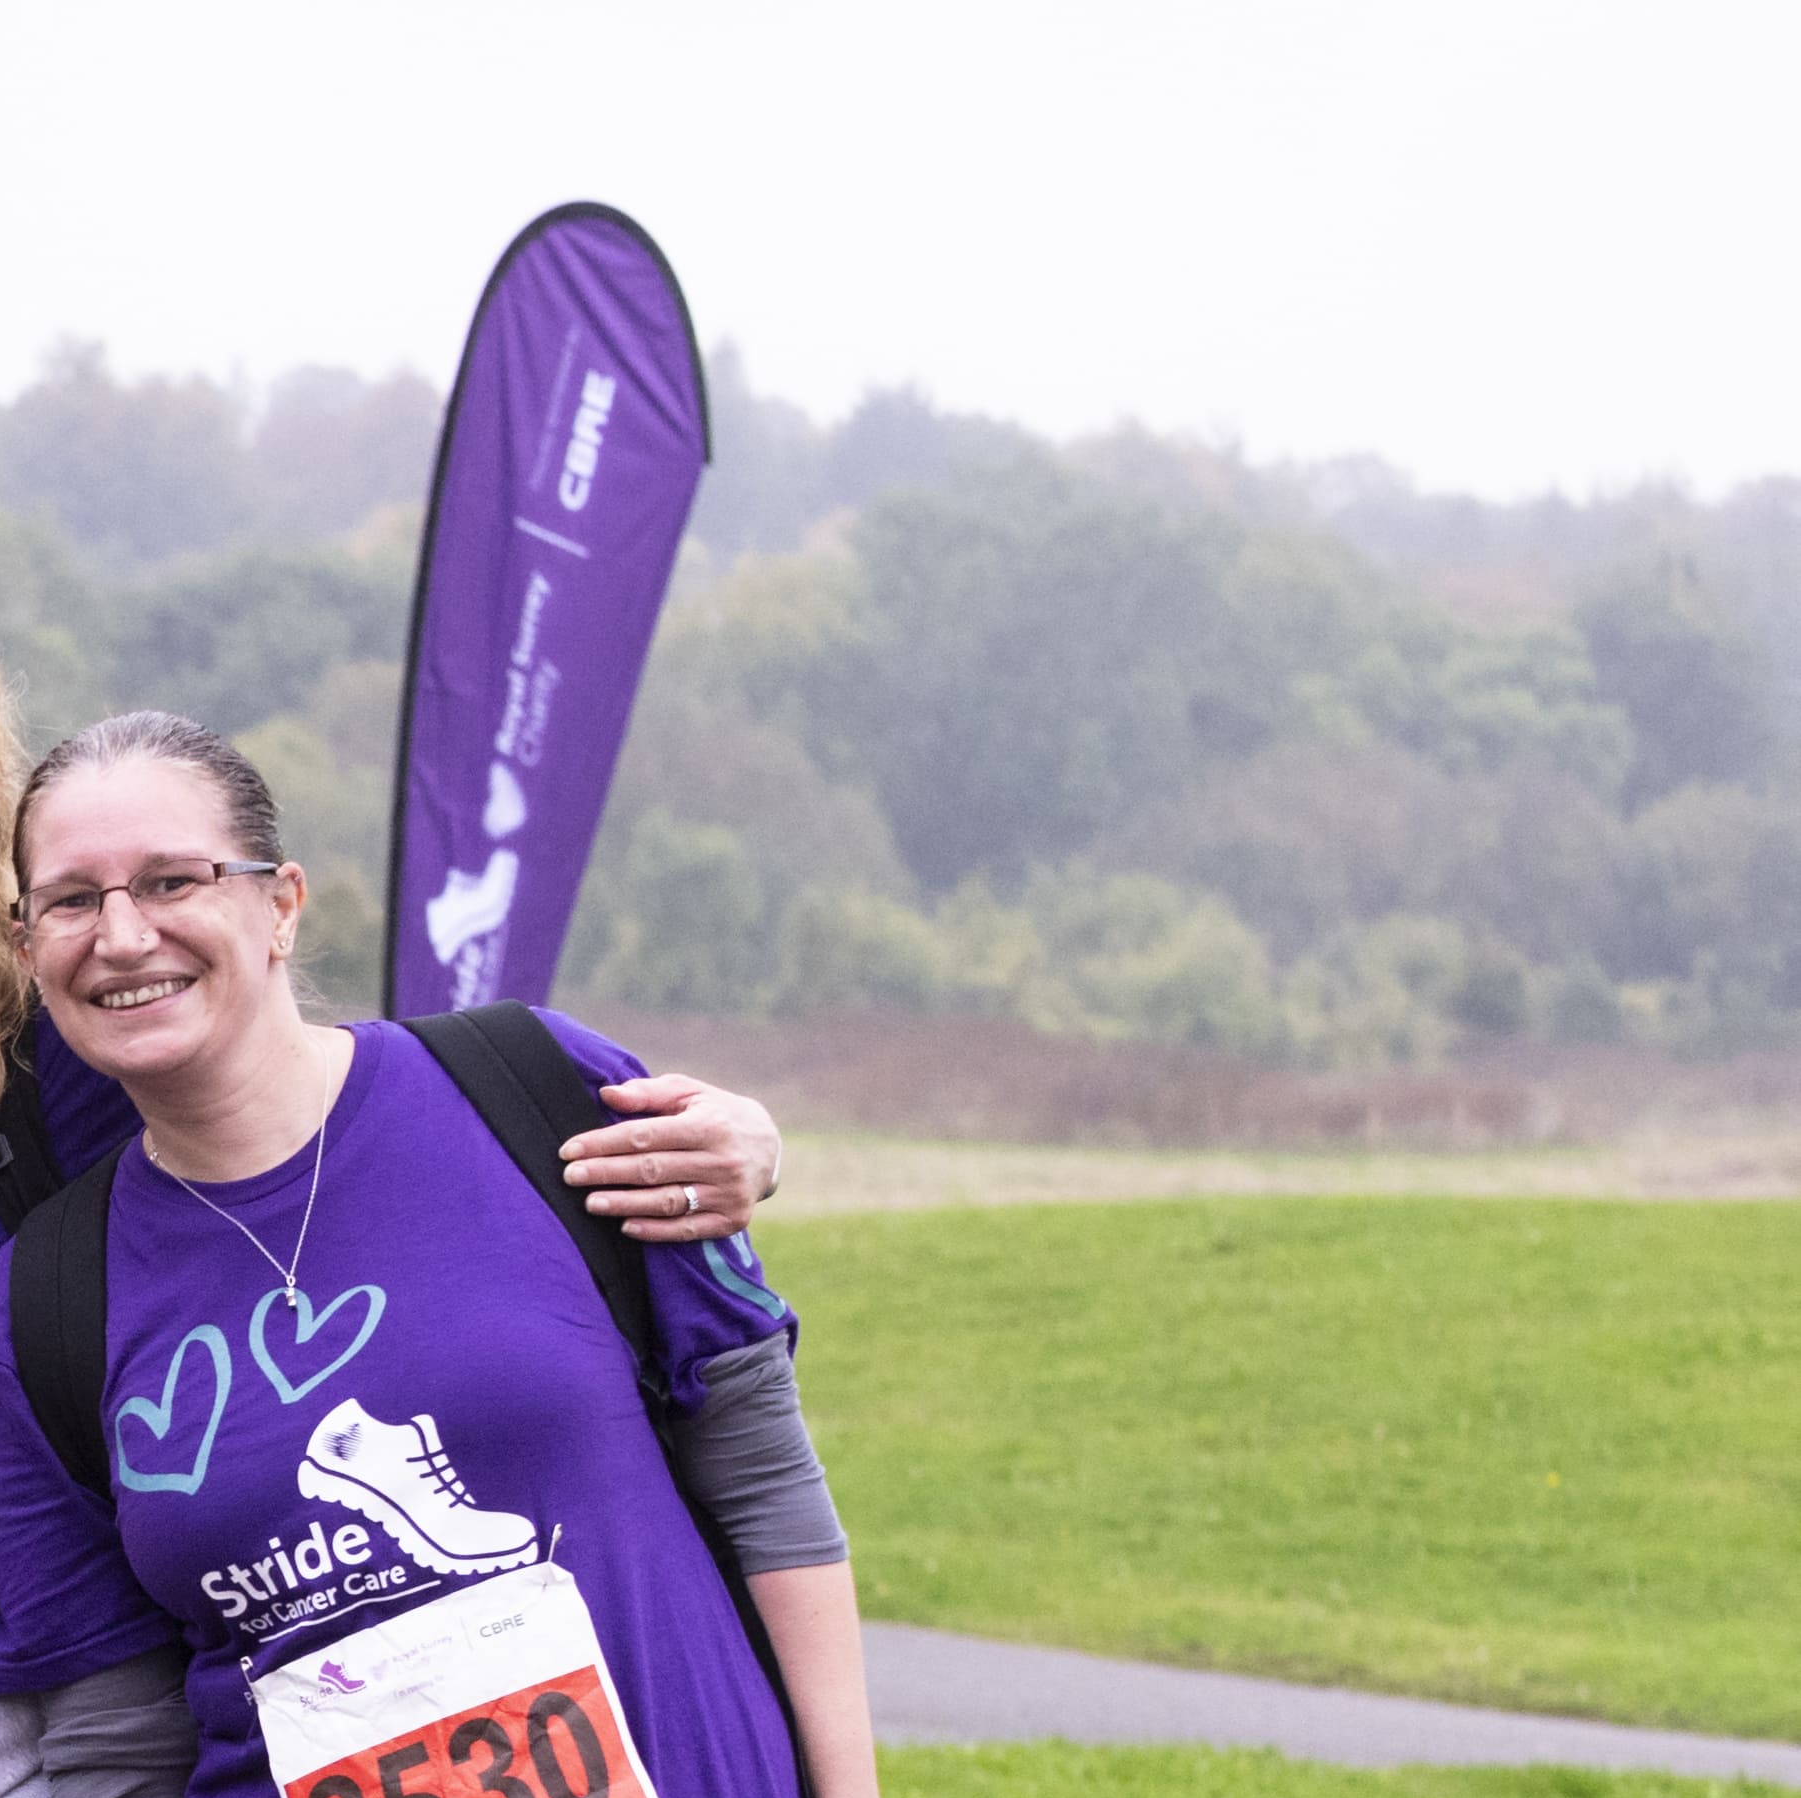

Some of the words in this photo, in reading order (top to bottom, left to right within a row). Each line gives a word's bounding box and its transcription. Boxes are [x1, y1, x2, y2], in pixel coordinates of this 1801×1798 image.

[557, 368, 617, 512] CBRE
[200, 1520, 374, 1619] Stride
[239, 1610, 275, 1634] for
[270, 1586, 338, 1622] Cancer
[342, 1564, 408, 1595] Care
[479, 1613, 526, 1639] CBRE
